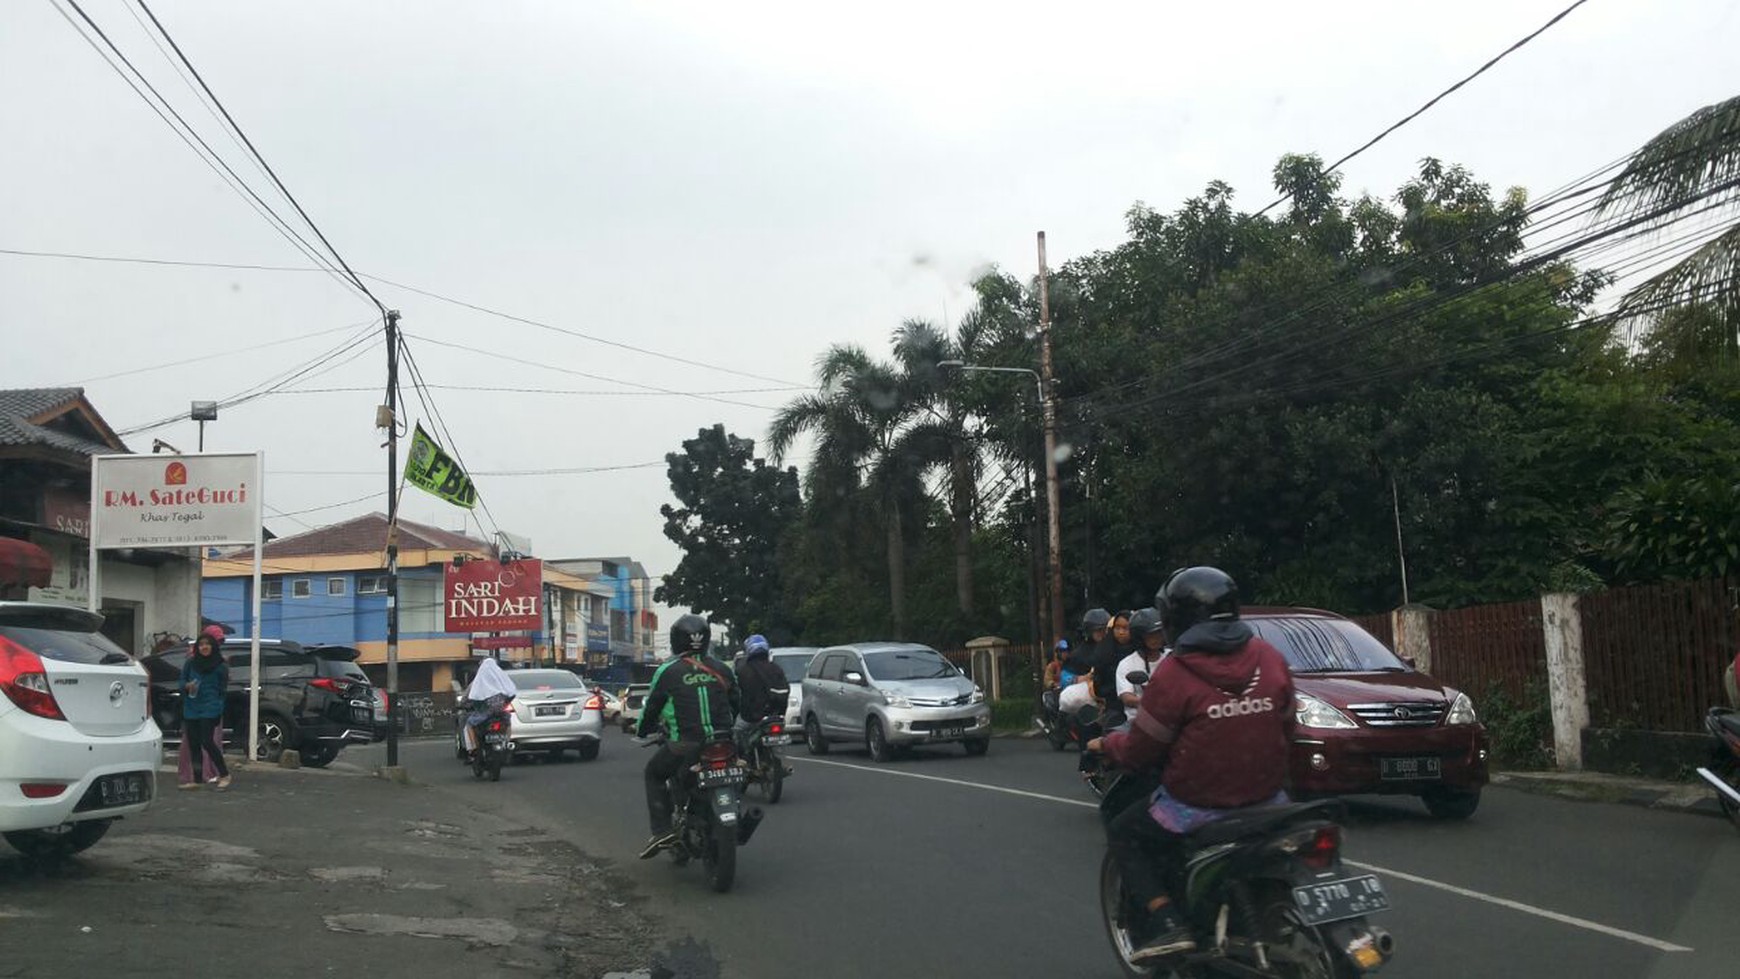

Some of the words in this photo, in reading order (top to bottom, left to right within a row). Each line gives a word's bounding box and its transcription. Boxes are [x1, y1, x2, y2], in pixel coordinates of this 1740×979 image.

[105, 490, 145, 507] RM.
[150, 483, 246, 507] SateGuci
[140, 512, 169, 523] Khas
[171, 511, 205, 524] Tegal
[454, 581, 501, 598] SARI
[448, 597, 538, 619] INDAH
[1207, 695, 1273, 719] adidas
